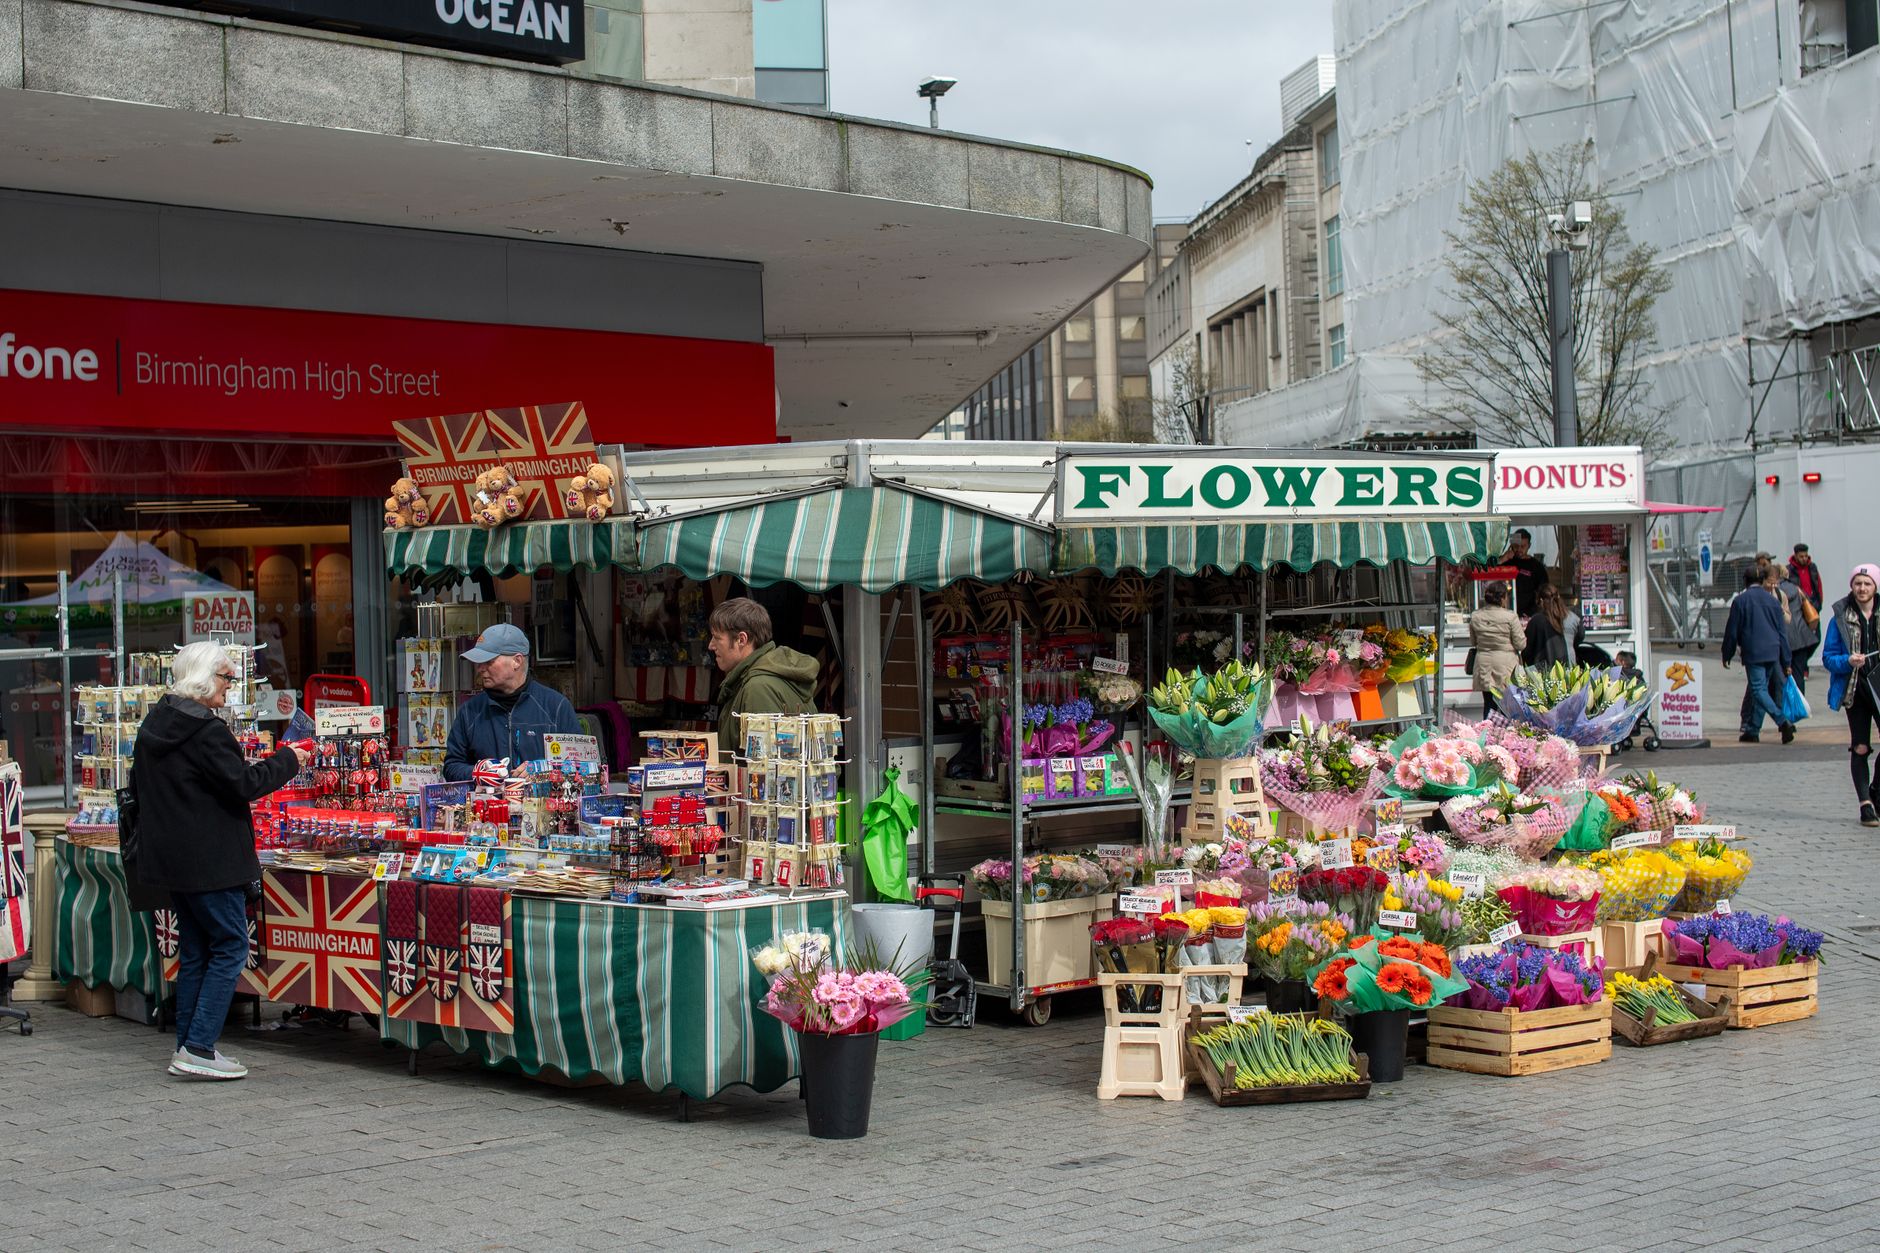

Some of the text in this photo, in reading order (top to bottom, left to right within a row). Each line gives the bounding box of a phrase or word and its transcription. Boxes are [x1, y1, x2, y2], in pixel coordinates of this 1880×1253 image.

[435, 0, 570, 43] OCEAN
[0, 332, 98, 381] fone
[136, 352, 441, 400] Birmingham High Street
[1074, 464, 1484, 509] FLOWERS
[1501, 463, 1627, 490] DONUTS
[193, 596, 253, 620] DATA
[193, 620, 253, 635] ROLLOVER
[329, 688, 353, 697] vodafone
[1663, 692, 1697, 703] Potato
[1661, 702, 1701, 713] Wedges
[321, 720, 331, 729] £2
[371, 720, 380, 728] £5
[272, 927, 375, 957] BIRMINGHAM
